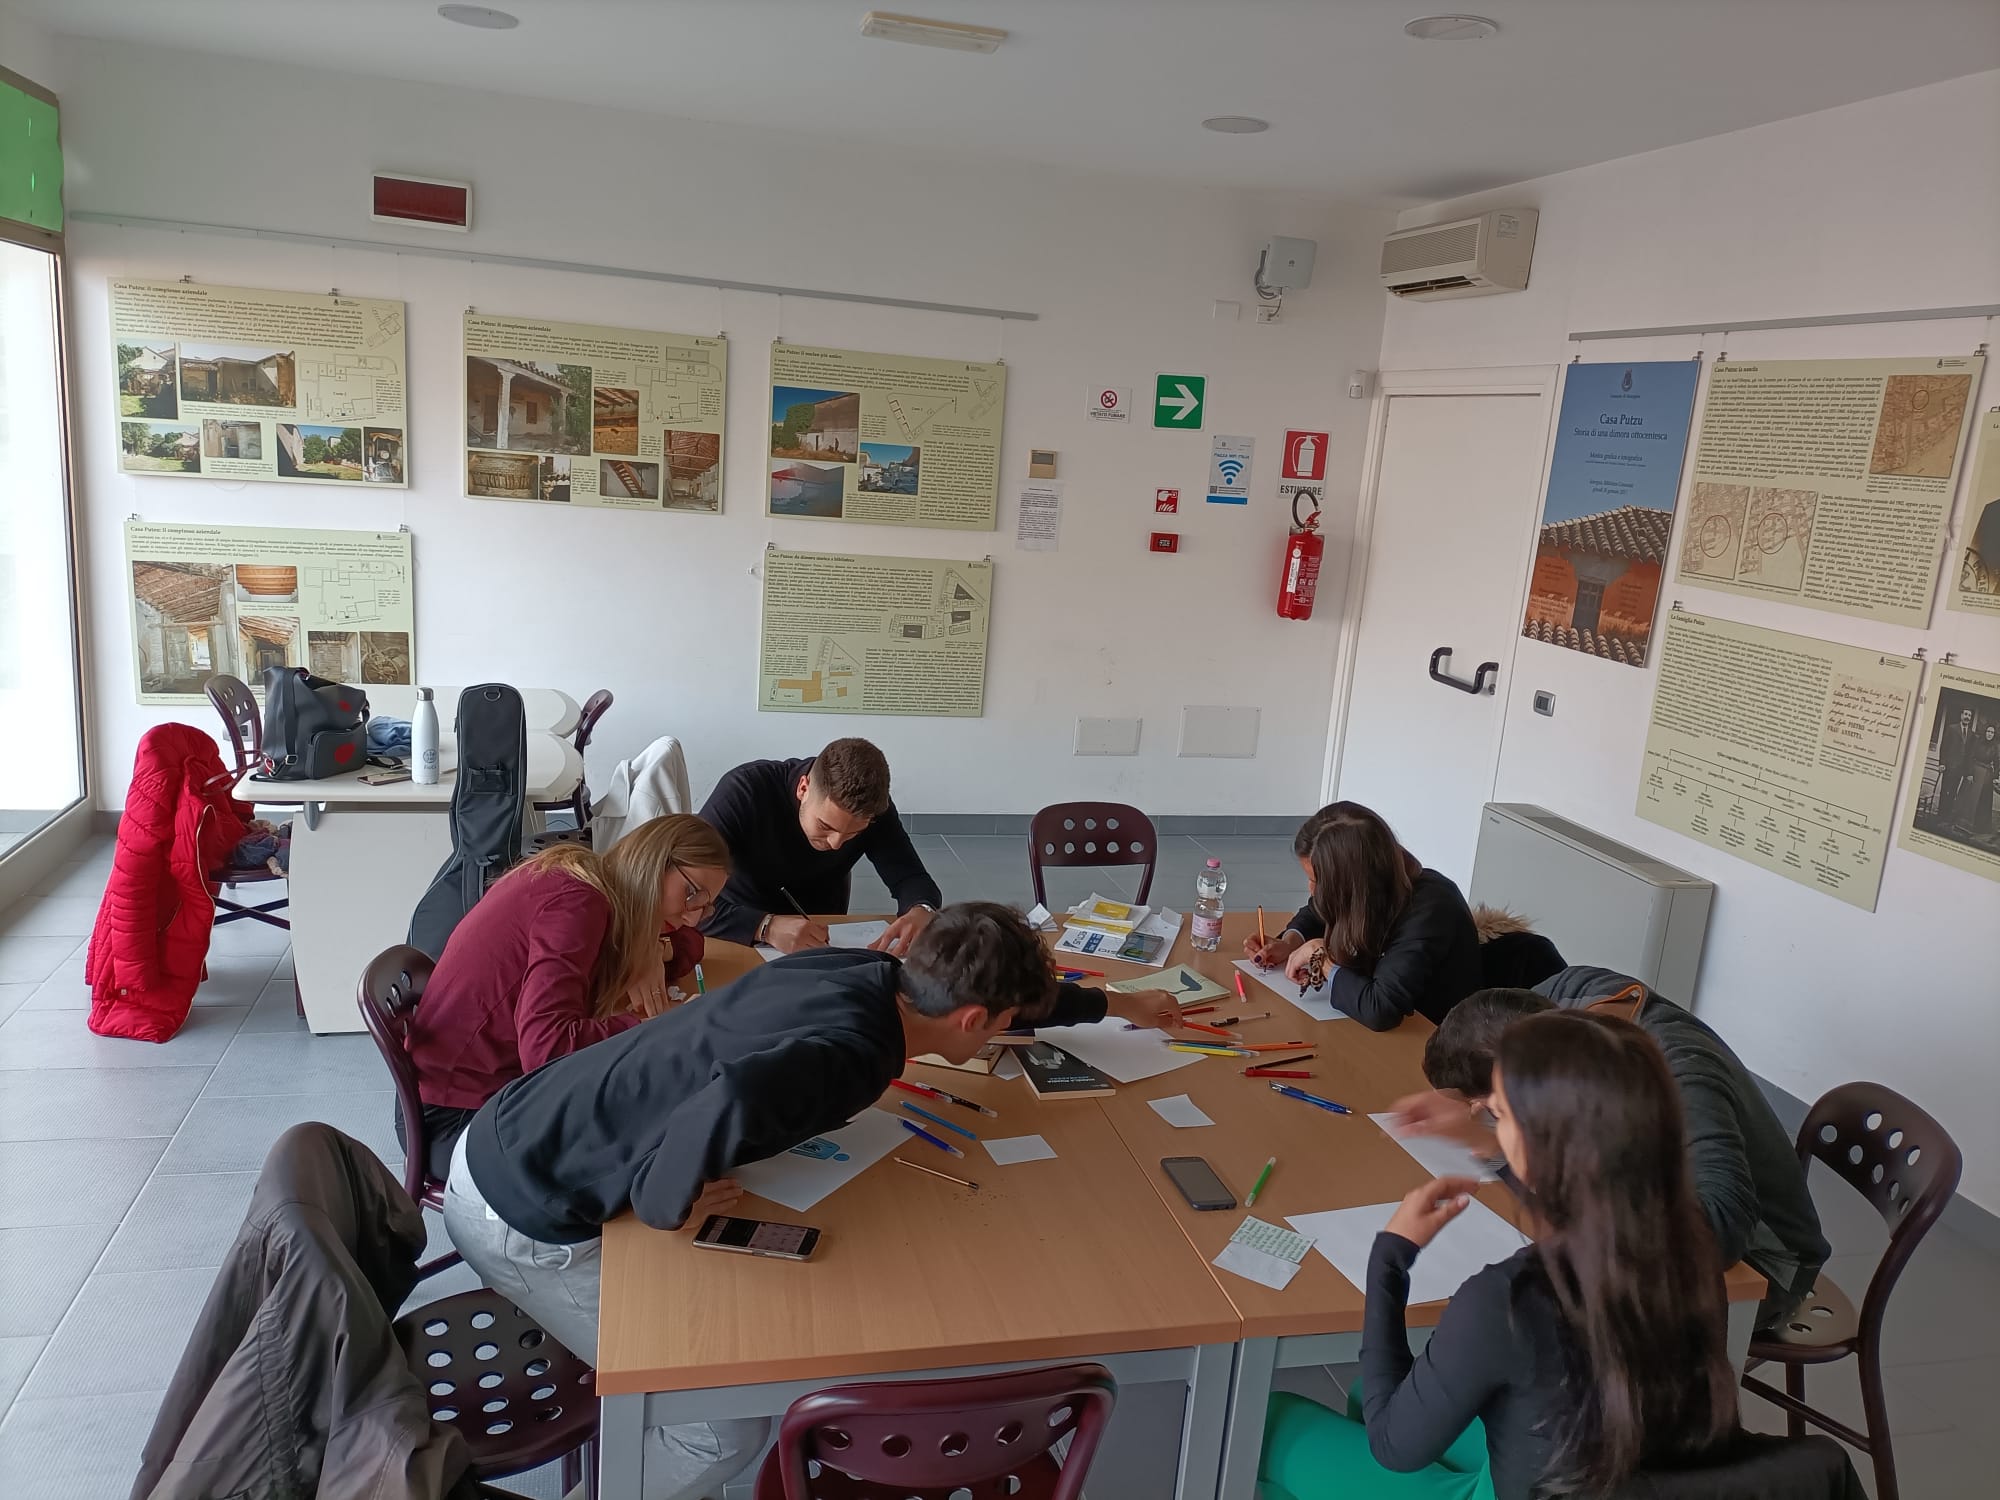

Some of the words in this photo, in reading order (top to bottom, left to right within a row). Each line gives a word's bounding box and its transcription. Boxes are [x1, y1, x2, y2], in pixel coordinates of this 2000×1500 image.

[1600, 414, 1618, 424] Casa
[1619, 414, 1643, 426] Putzu
[1574, 428, 1590, 436] Storia
[1609, 430, 1630, 438] dimora
[1630, 432, 1668, 440] ottocentesca
